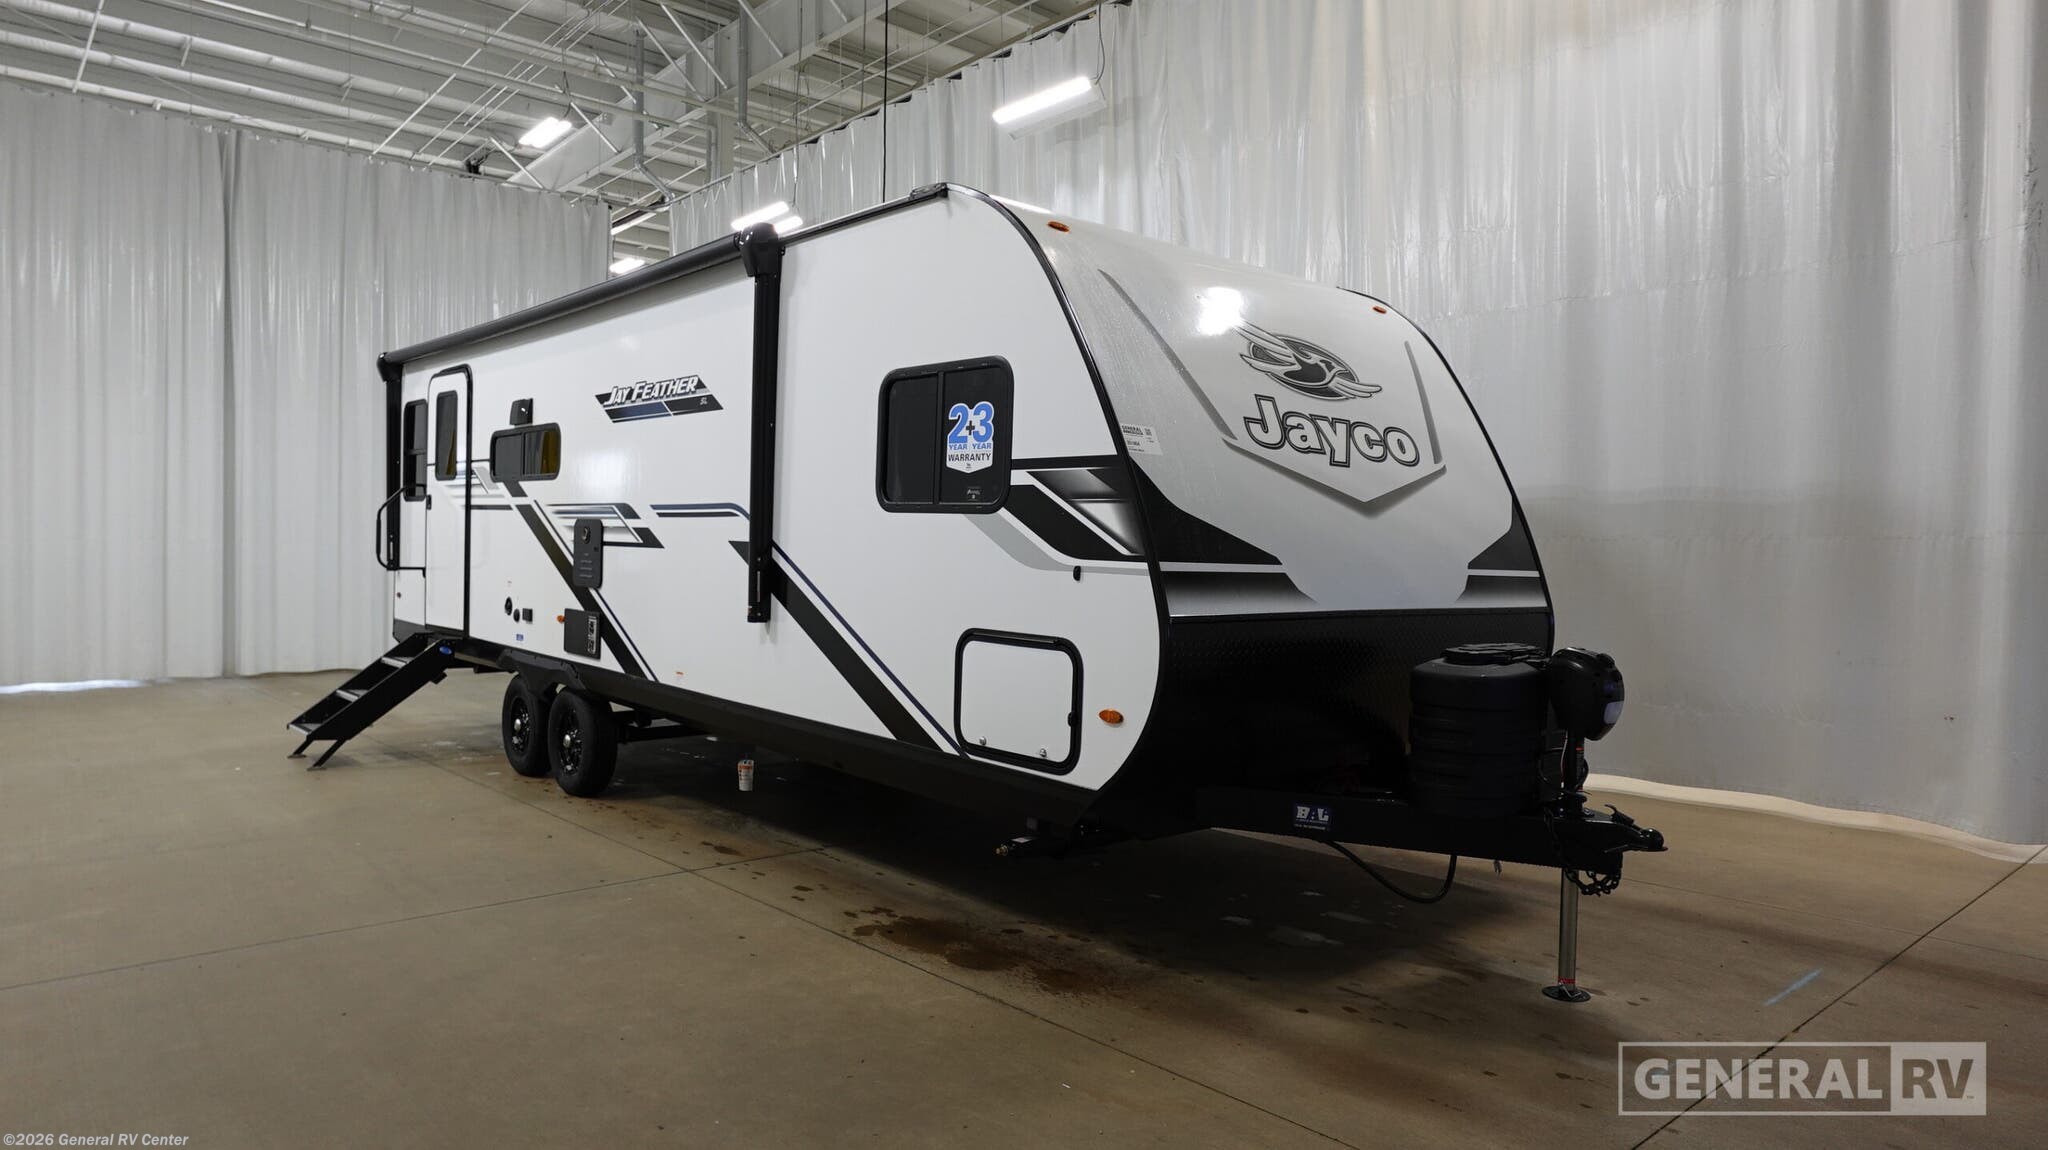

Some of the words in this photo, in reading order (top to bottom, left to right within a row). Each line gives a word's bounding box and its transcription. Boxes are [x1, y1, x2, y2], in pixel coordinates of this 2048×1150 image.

[602, 386, 632, 408] JAY
[630, 374, 699, 403] FEATHER
[1243, 393, 1420, 468] Jayco
[948, 453, 992, 462] WARRANTY
